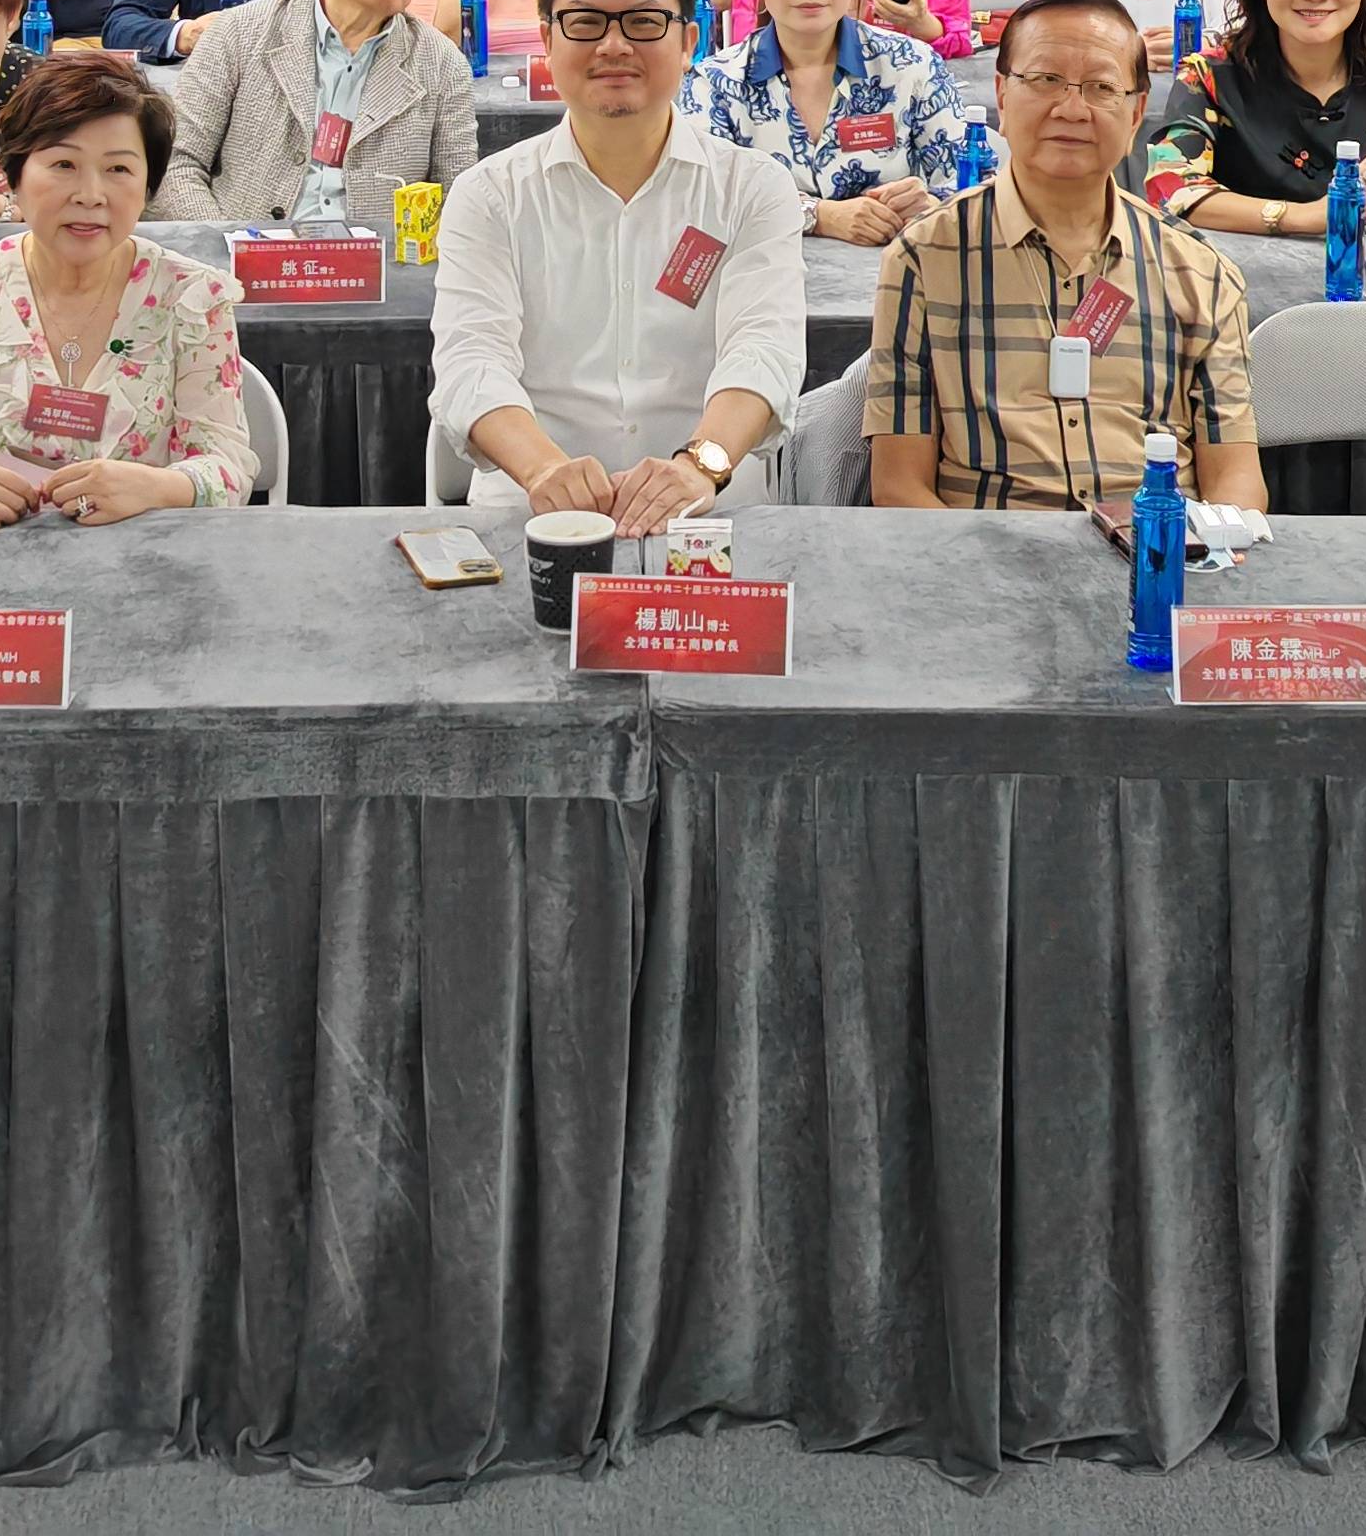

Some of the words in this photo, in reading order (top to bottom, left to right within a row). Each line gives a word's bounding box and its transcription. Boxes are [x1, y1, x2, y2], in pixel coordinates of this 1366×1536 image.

[634, 606, 704, 632] 楊凱山
[623, 635, 740, 653] 全港各區工商聯會長
